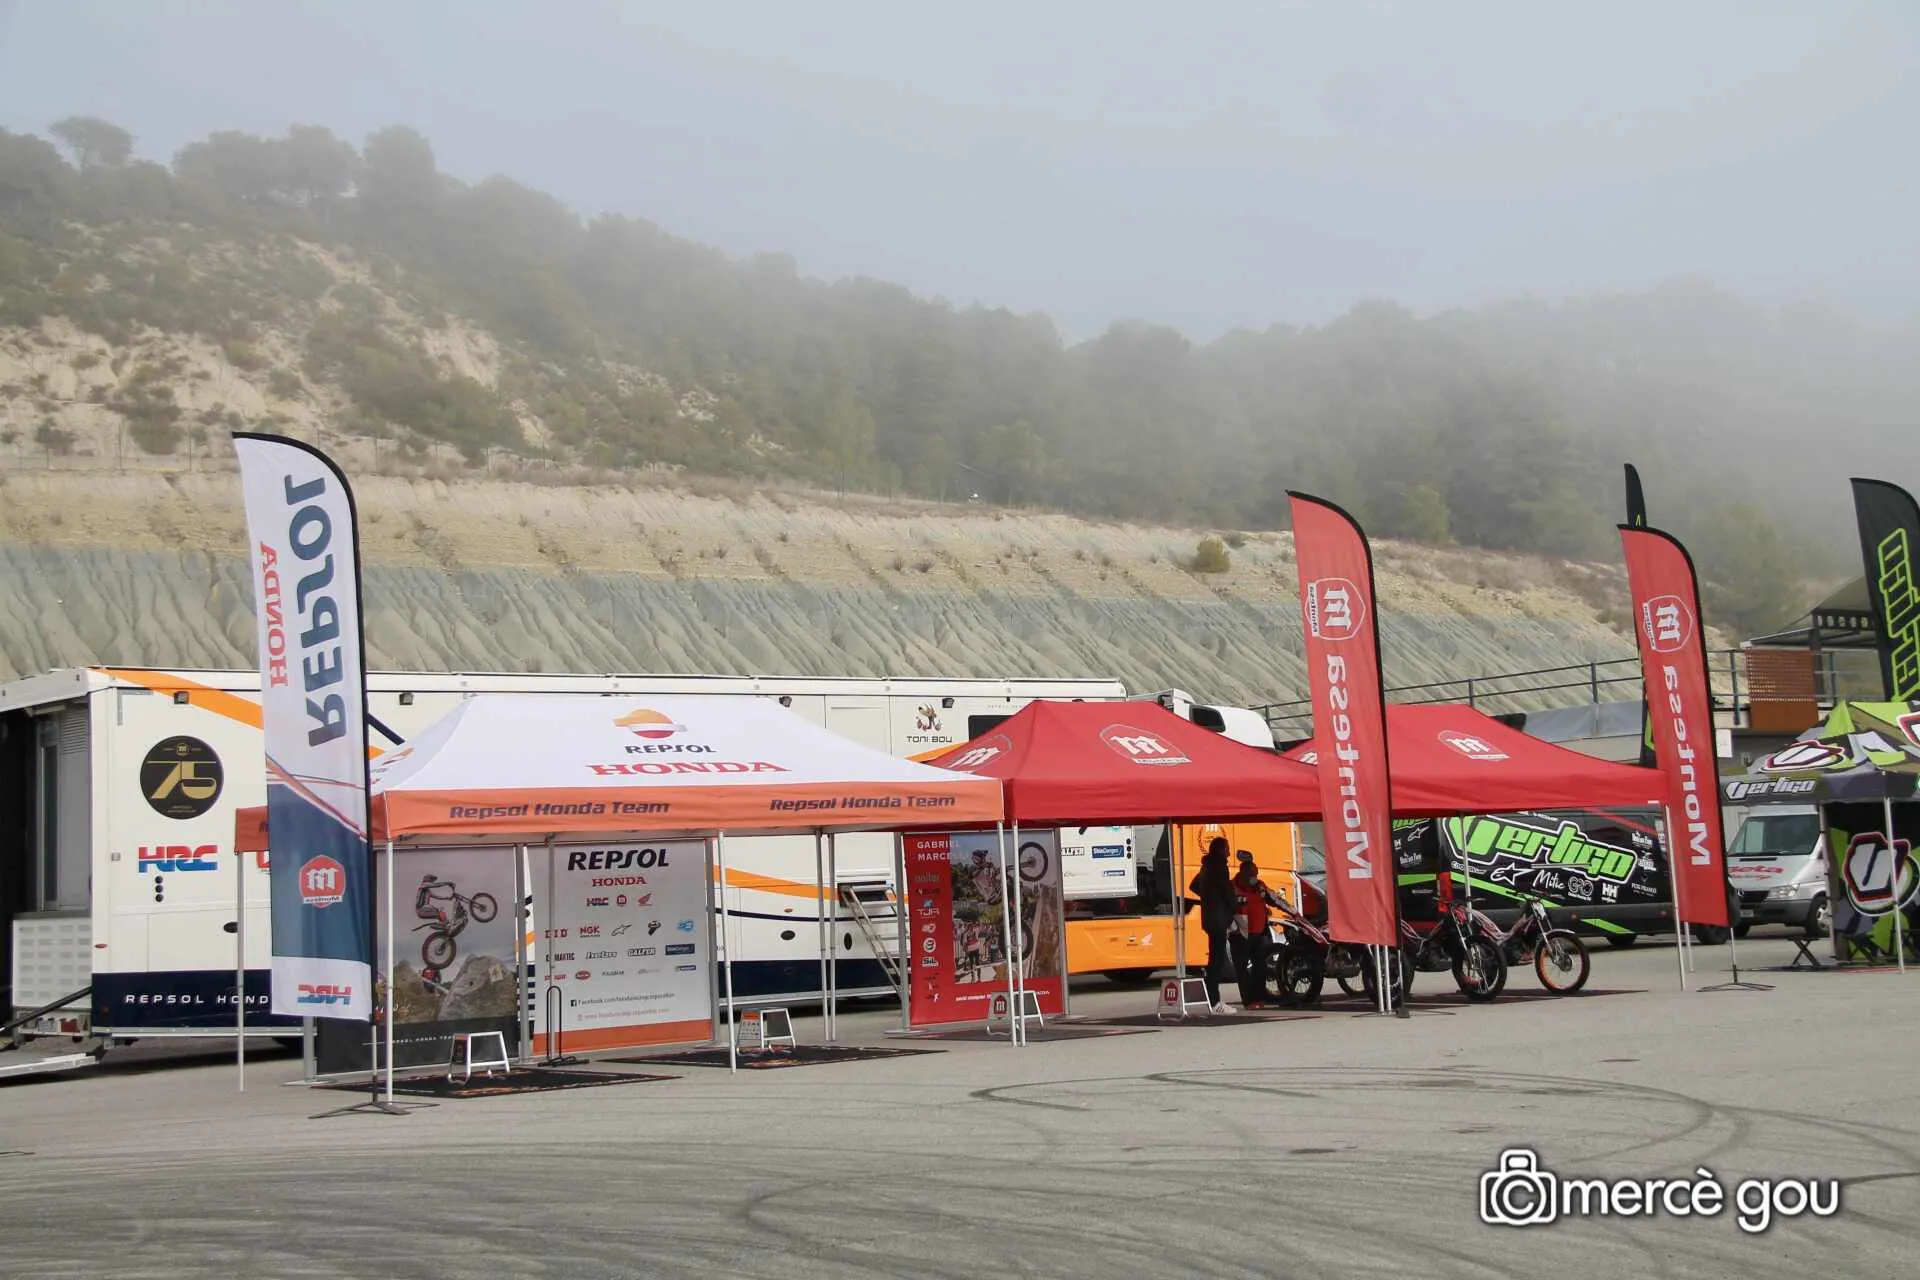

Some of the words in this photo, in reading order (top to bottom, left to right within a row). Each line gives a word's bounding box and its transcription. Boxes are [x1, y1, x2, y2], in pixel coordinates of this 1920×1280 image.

[906, 735, 929, 743] TONI
[931, 735, 953, 743] BOU
[624, 744, 717, 755] REPSOL
[584, 760, 792, 776] HONDA
[450, 803, 529, 820] Repsol
[534, 801, 605, 816] Honda
[611, 801, 670, 814] Team
[769, 798, 837, 813] Repsol
[843, 796, 901, 810] Honda
[906, 795, 956, 808] Team
[137, 844, 218, 873] HRC
[567, 848, 670, 871] REPSOL
[592, 876, 648, 887] HONDA
[579, 924, 600, 935] NGK
[125, 993, 205, 1005] REPSOL
[217, 993, 270, 1005] HOND
